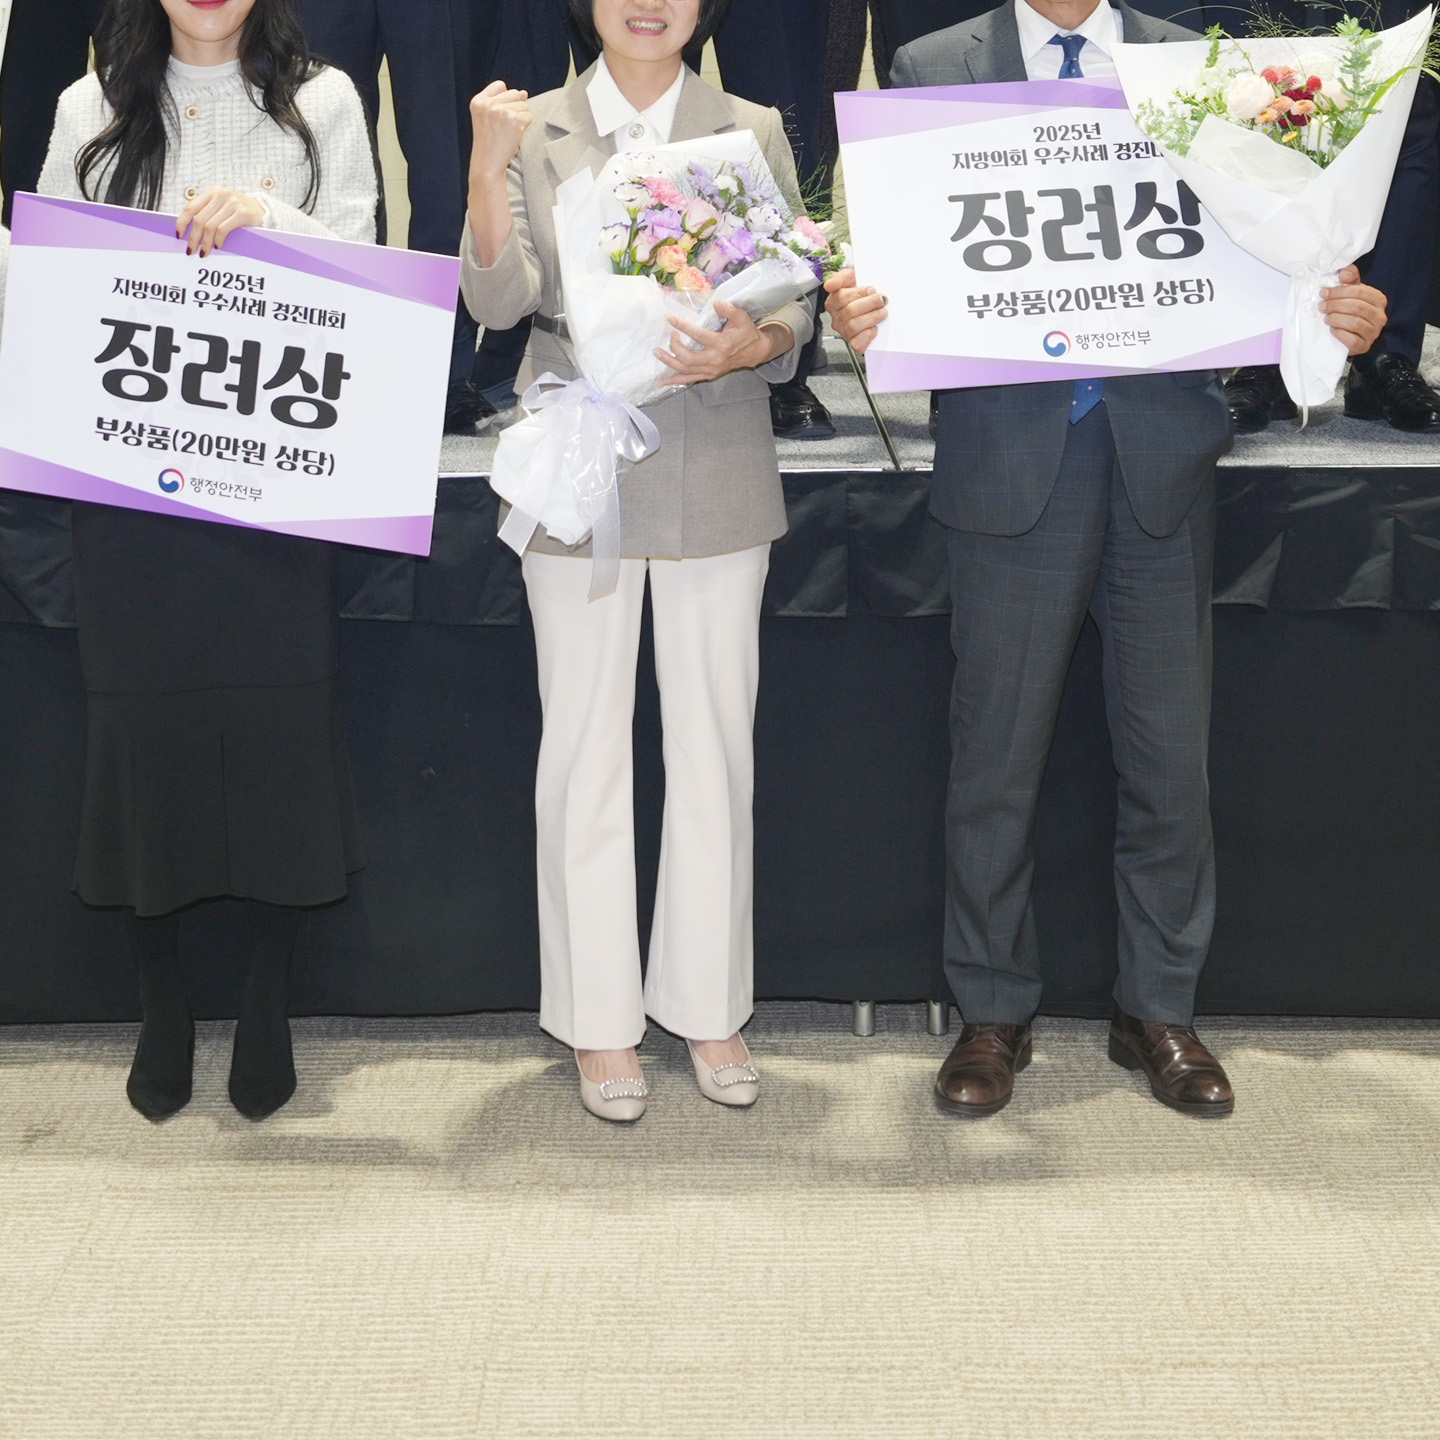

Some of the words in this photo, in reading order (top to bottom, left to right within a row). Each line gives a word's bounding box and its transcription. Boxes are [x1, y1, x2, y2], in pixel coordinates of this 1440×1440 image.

[1033, 122, 1101, 143] 2025년
[952, 147, 1028, 170] 지방의회
[1034, 143, 1109, 164] 우수사례
[947, 179, 1205, 273] 장려상
[197, 268, 265, 294] 2025년
[966, 283, 1145, 320] 부상품(20만원
[1153, 277, 1215, 306] 상당)
[112, 277, 186, 305] 지방의회
[193, 290, 266, 317] 우수사례
[272, 301, 346, 330] 경진대회
[1075, 330, 1152, 351] 행정안전부
[94, 316, 351, 430] 장려상
[94, 415, 266, 467] 부상품(20만원
[273, 444, 335, 477] 상당)
[189, 476, 262, 503] 행정안전부
